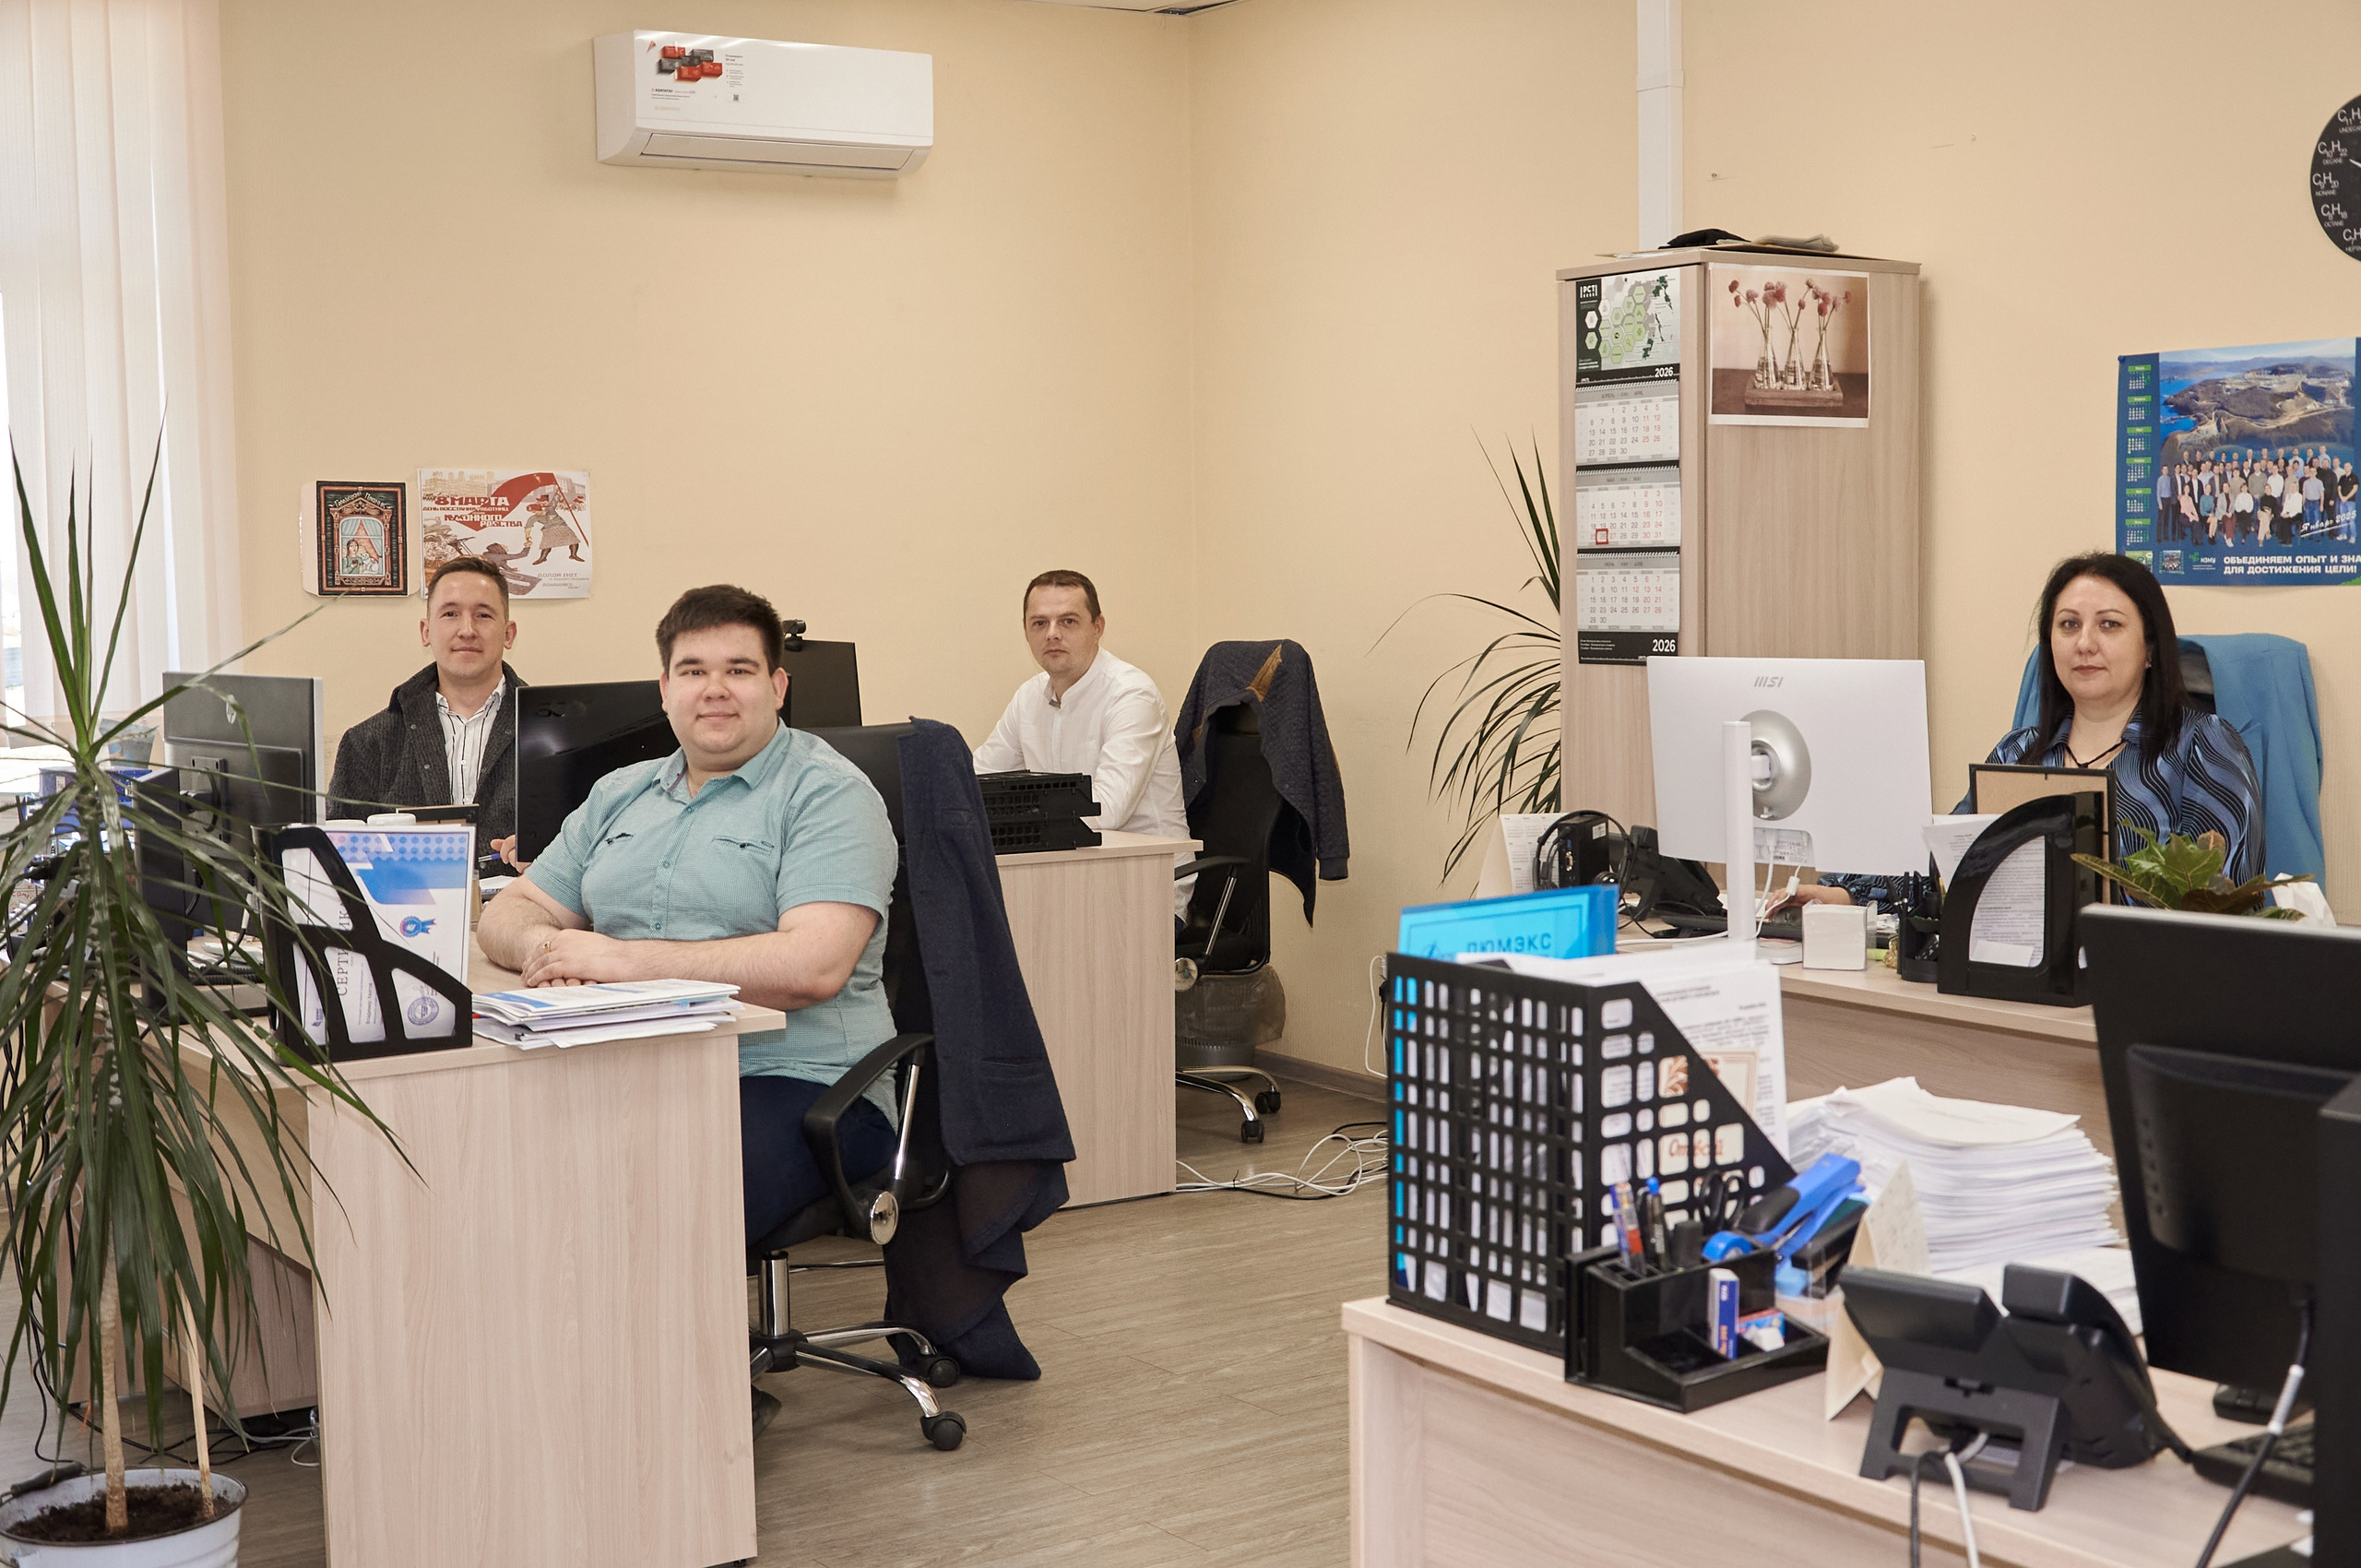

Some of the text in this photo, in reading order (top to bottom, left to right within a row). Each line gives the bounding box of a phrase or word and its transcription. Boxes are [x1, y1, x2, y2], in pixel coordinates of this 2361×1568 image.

[1655, 367, 1674, 378] 2026
[434, 496, 509, 505] 8 МАРТА
[2300, 519, 2333, 532] Январь
[2224, 555, 2292, 564] ОБЪЕДИНЯЕМ
[2295, 555, 2326, 564] ОПЫТ
[2224, 564, 2357, 575] ДЛЯ ДОСТИЖЕНИЯ ЦЕЛИ!
[1653, 639, 1676, 652] 2026
[1754, 676, 1784, 687] MSI
